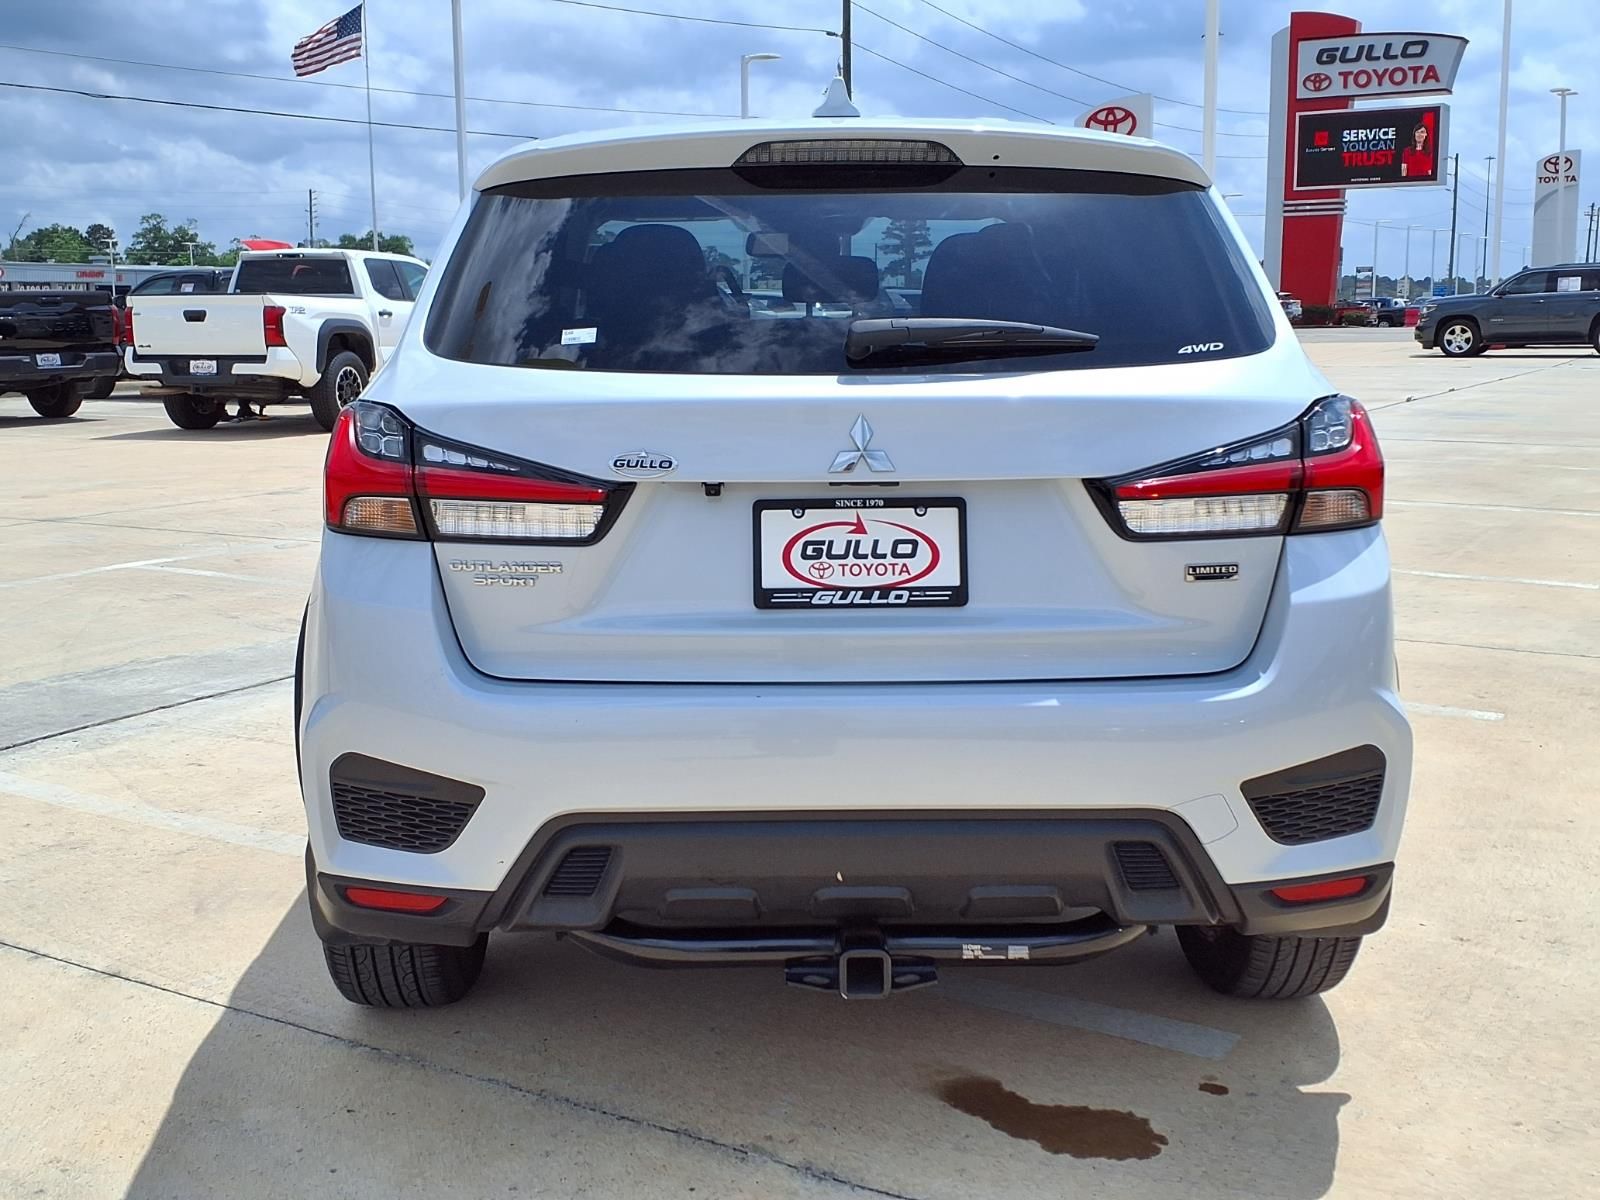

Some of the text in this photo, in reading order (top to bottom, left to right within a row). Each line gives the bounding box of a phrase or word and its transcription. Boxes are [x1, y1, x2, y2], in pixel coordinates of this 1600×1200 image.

[1316, 40, 1429, 65] GULLO
[1338, 64, 1441, 89] TOYOTA
[1342, 127, 1396, 141] SERVICE
[1342, 142, 1368, 152] YOU
[1369, 140, 1395, 150] CAN
[1342, 150, 1395, 167] TRUST
[1177, 342, 1224, 354] 4WD
[613, 459, 673, 469] GULLO
[866, 499, 884, 507] 1970
[800, 539, 919, 560] GULLO
[449, 559, 563, 573] OUTLANDER
[838, 563, 911, 577] TOYOTA
[1188, 565, 1238, 575] LIMITED
[473, 573, 538, 587] SPORT
[811, 590, 909, 605] GULLO
